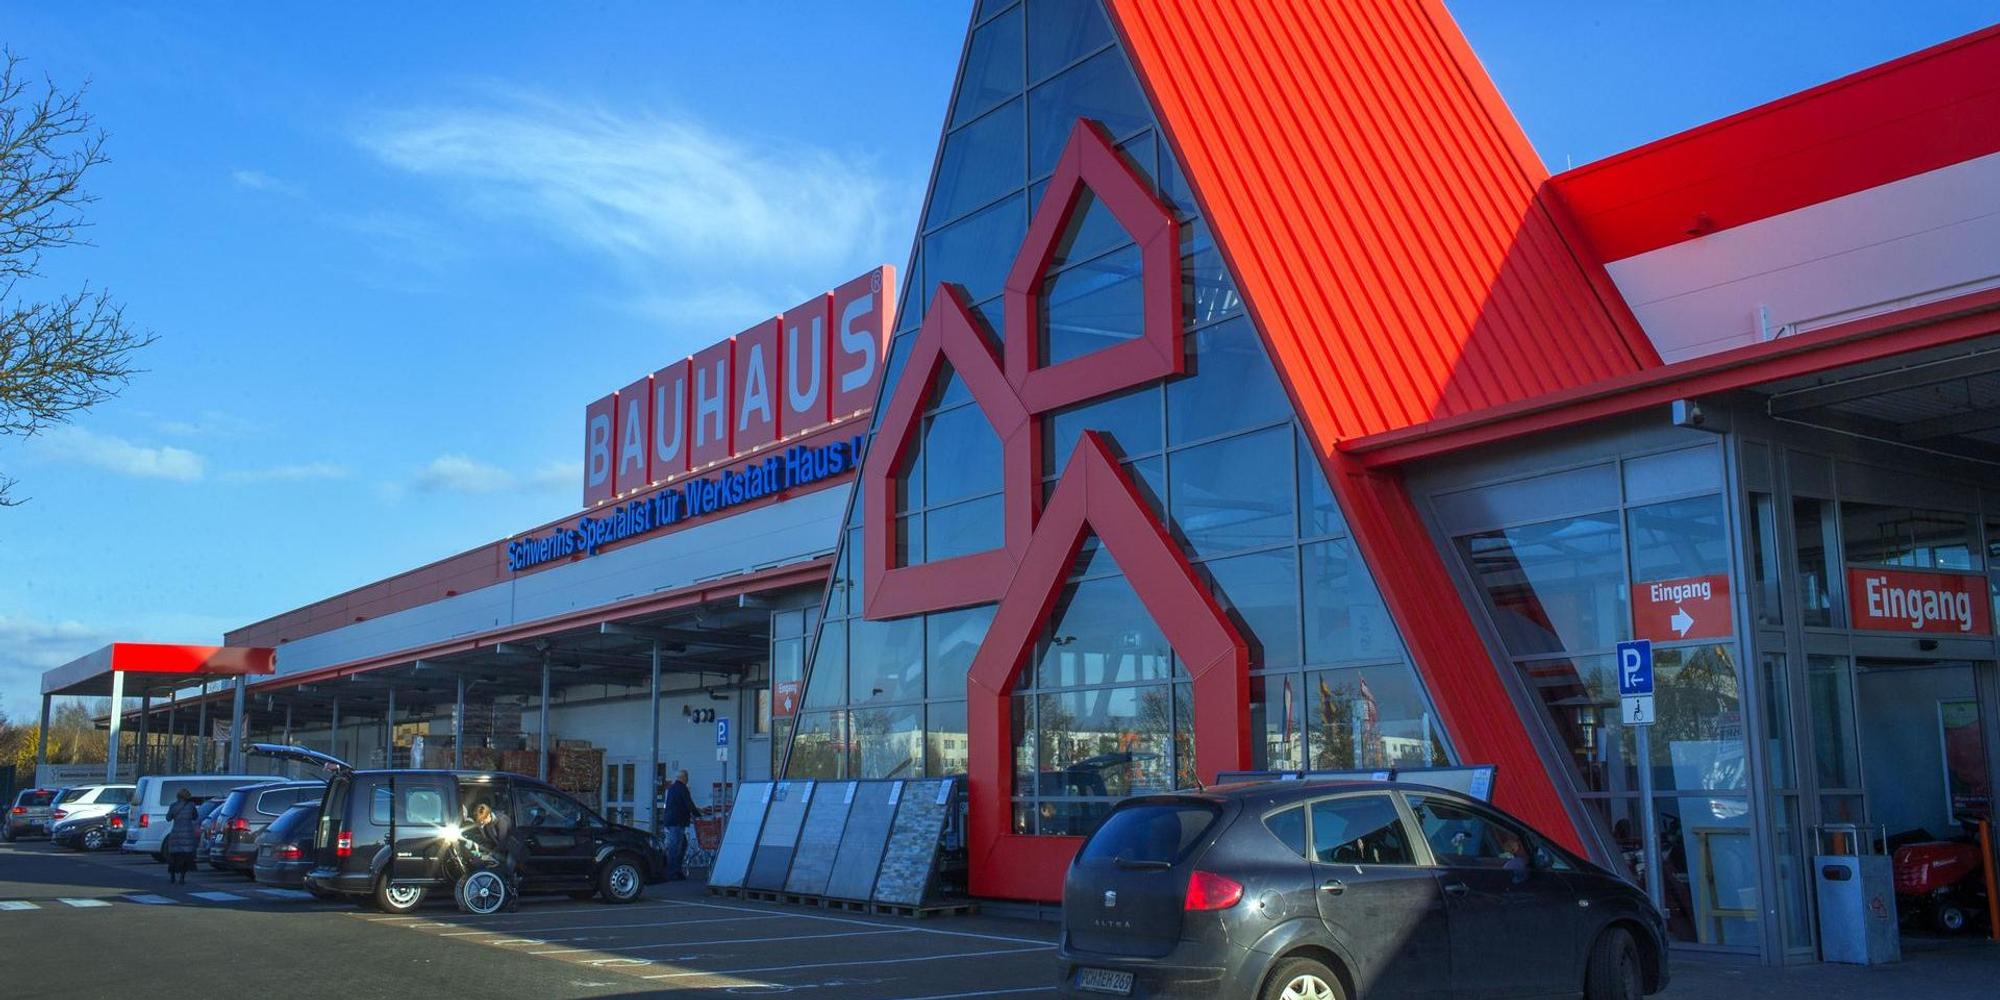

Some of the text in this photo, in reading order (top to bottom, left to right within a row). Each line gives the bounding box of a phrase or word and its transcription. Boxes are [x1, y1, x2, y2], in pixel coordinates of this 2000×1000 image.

[588, 291, 877, 488] BAUHAUS
[507, 528, 575, 572] Schwerins
[577, 497, 651, 556] Spezialist
[655, 488, 679, 527] für
[685, 457, 781, 518] Werkstatt
[785, 440, 845, 488] Haus
[1650, 580, 1712, 604] Eingang
[1866, 576, 1972, 632] Eingang
[1622, 648, 1642, 689] P
